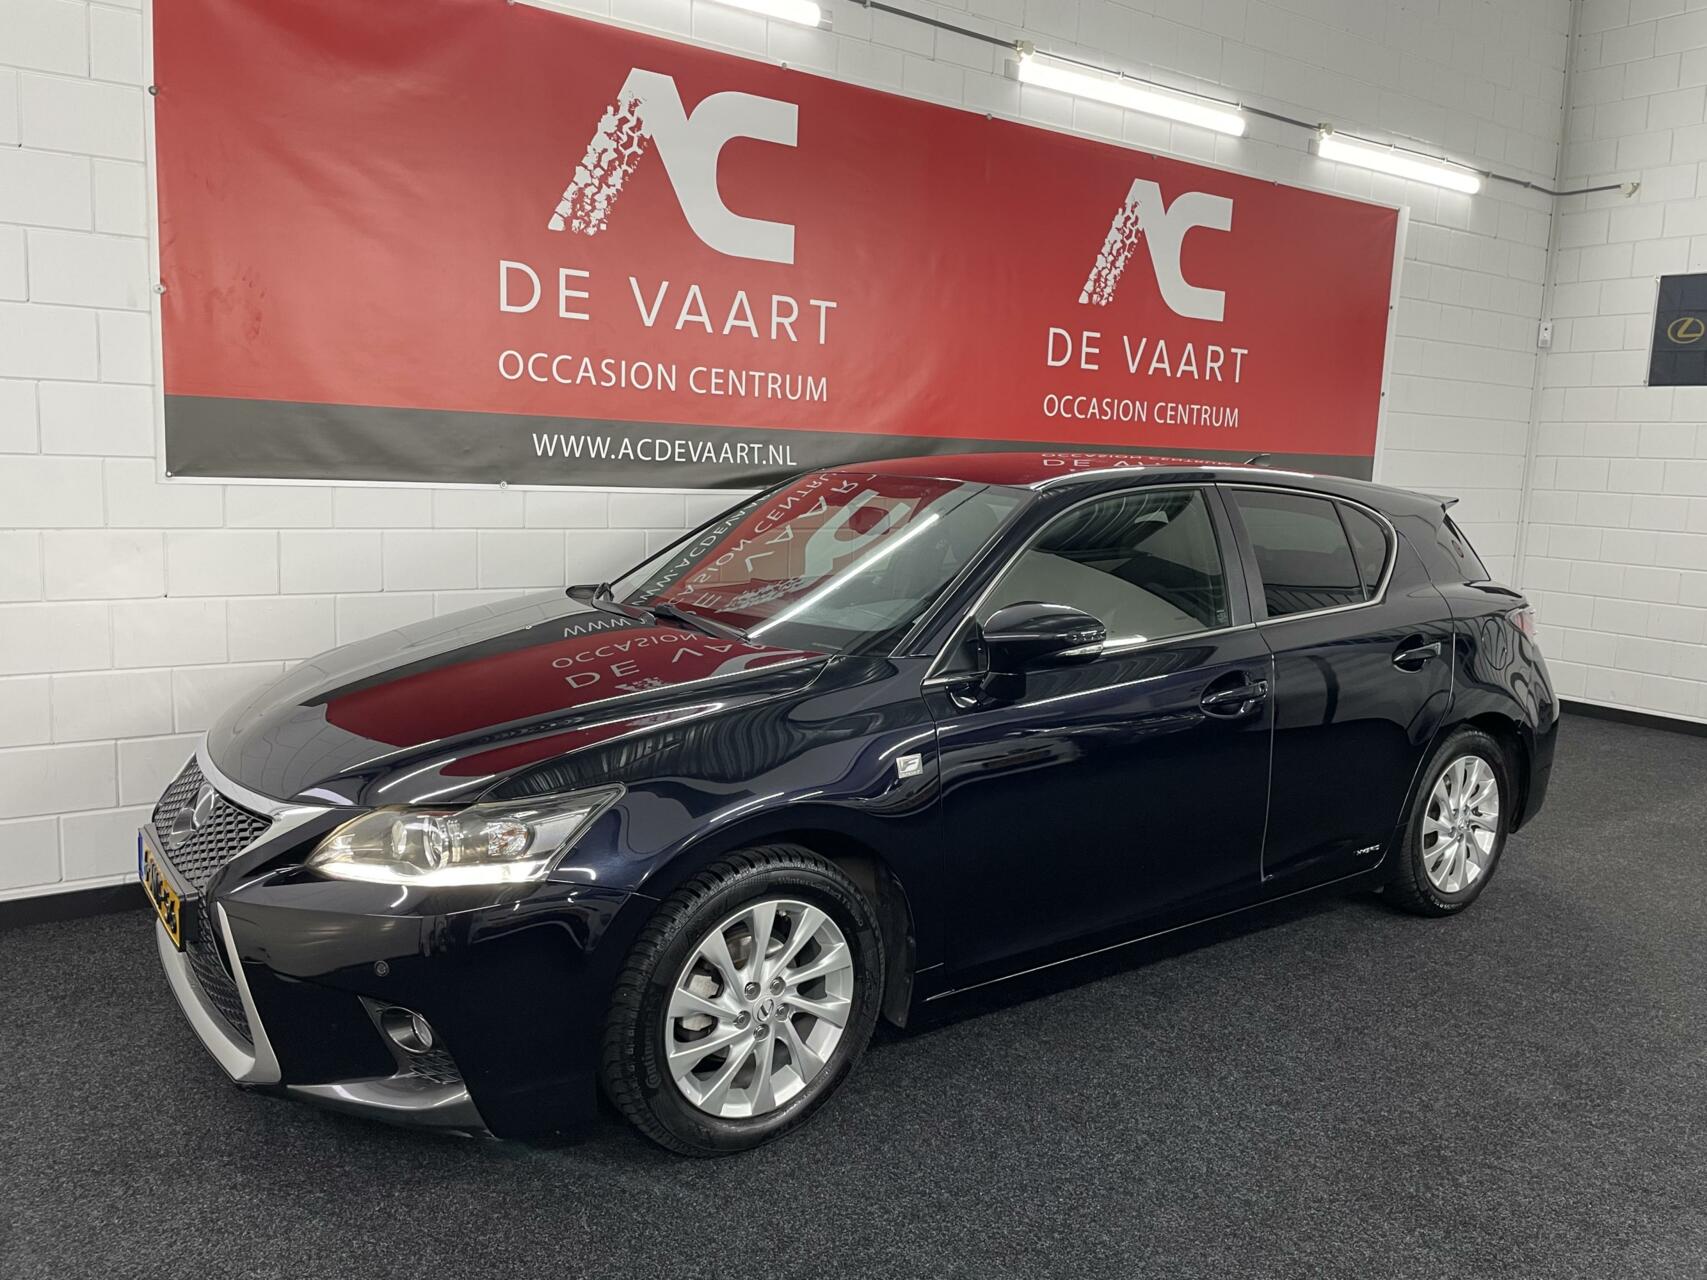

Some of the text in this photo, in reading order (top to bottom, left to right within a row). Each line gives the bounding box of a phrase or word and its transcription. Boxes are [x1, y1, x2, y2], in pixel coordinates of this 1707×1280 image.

[499, 259, 838, 345] DE VAART
[498, 350, 828, 402] OCCASION CENTRUM
[1046, 326, 1249, 383] DE VAART
[1043, 394, 1239, 428] OCCASION CENTRUM
[532, 433, 798, 466] WWW.ACDEVAART.NL
